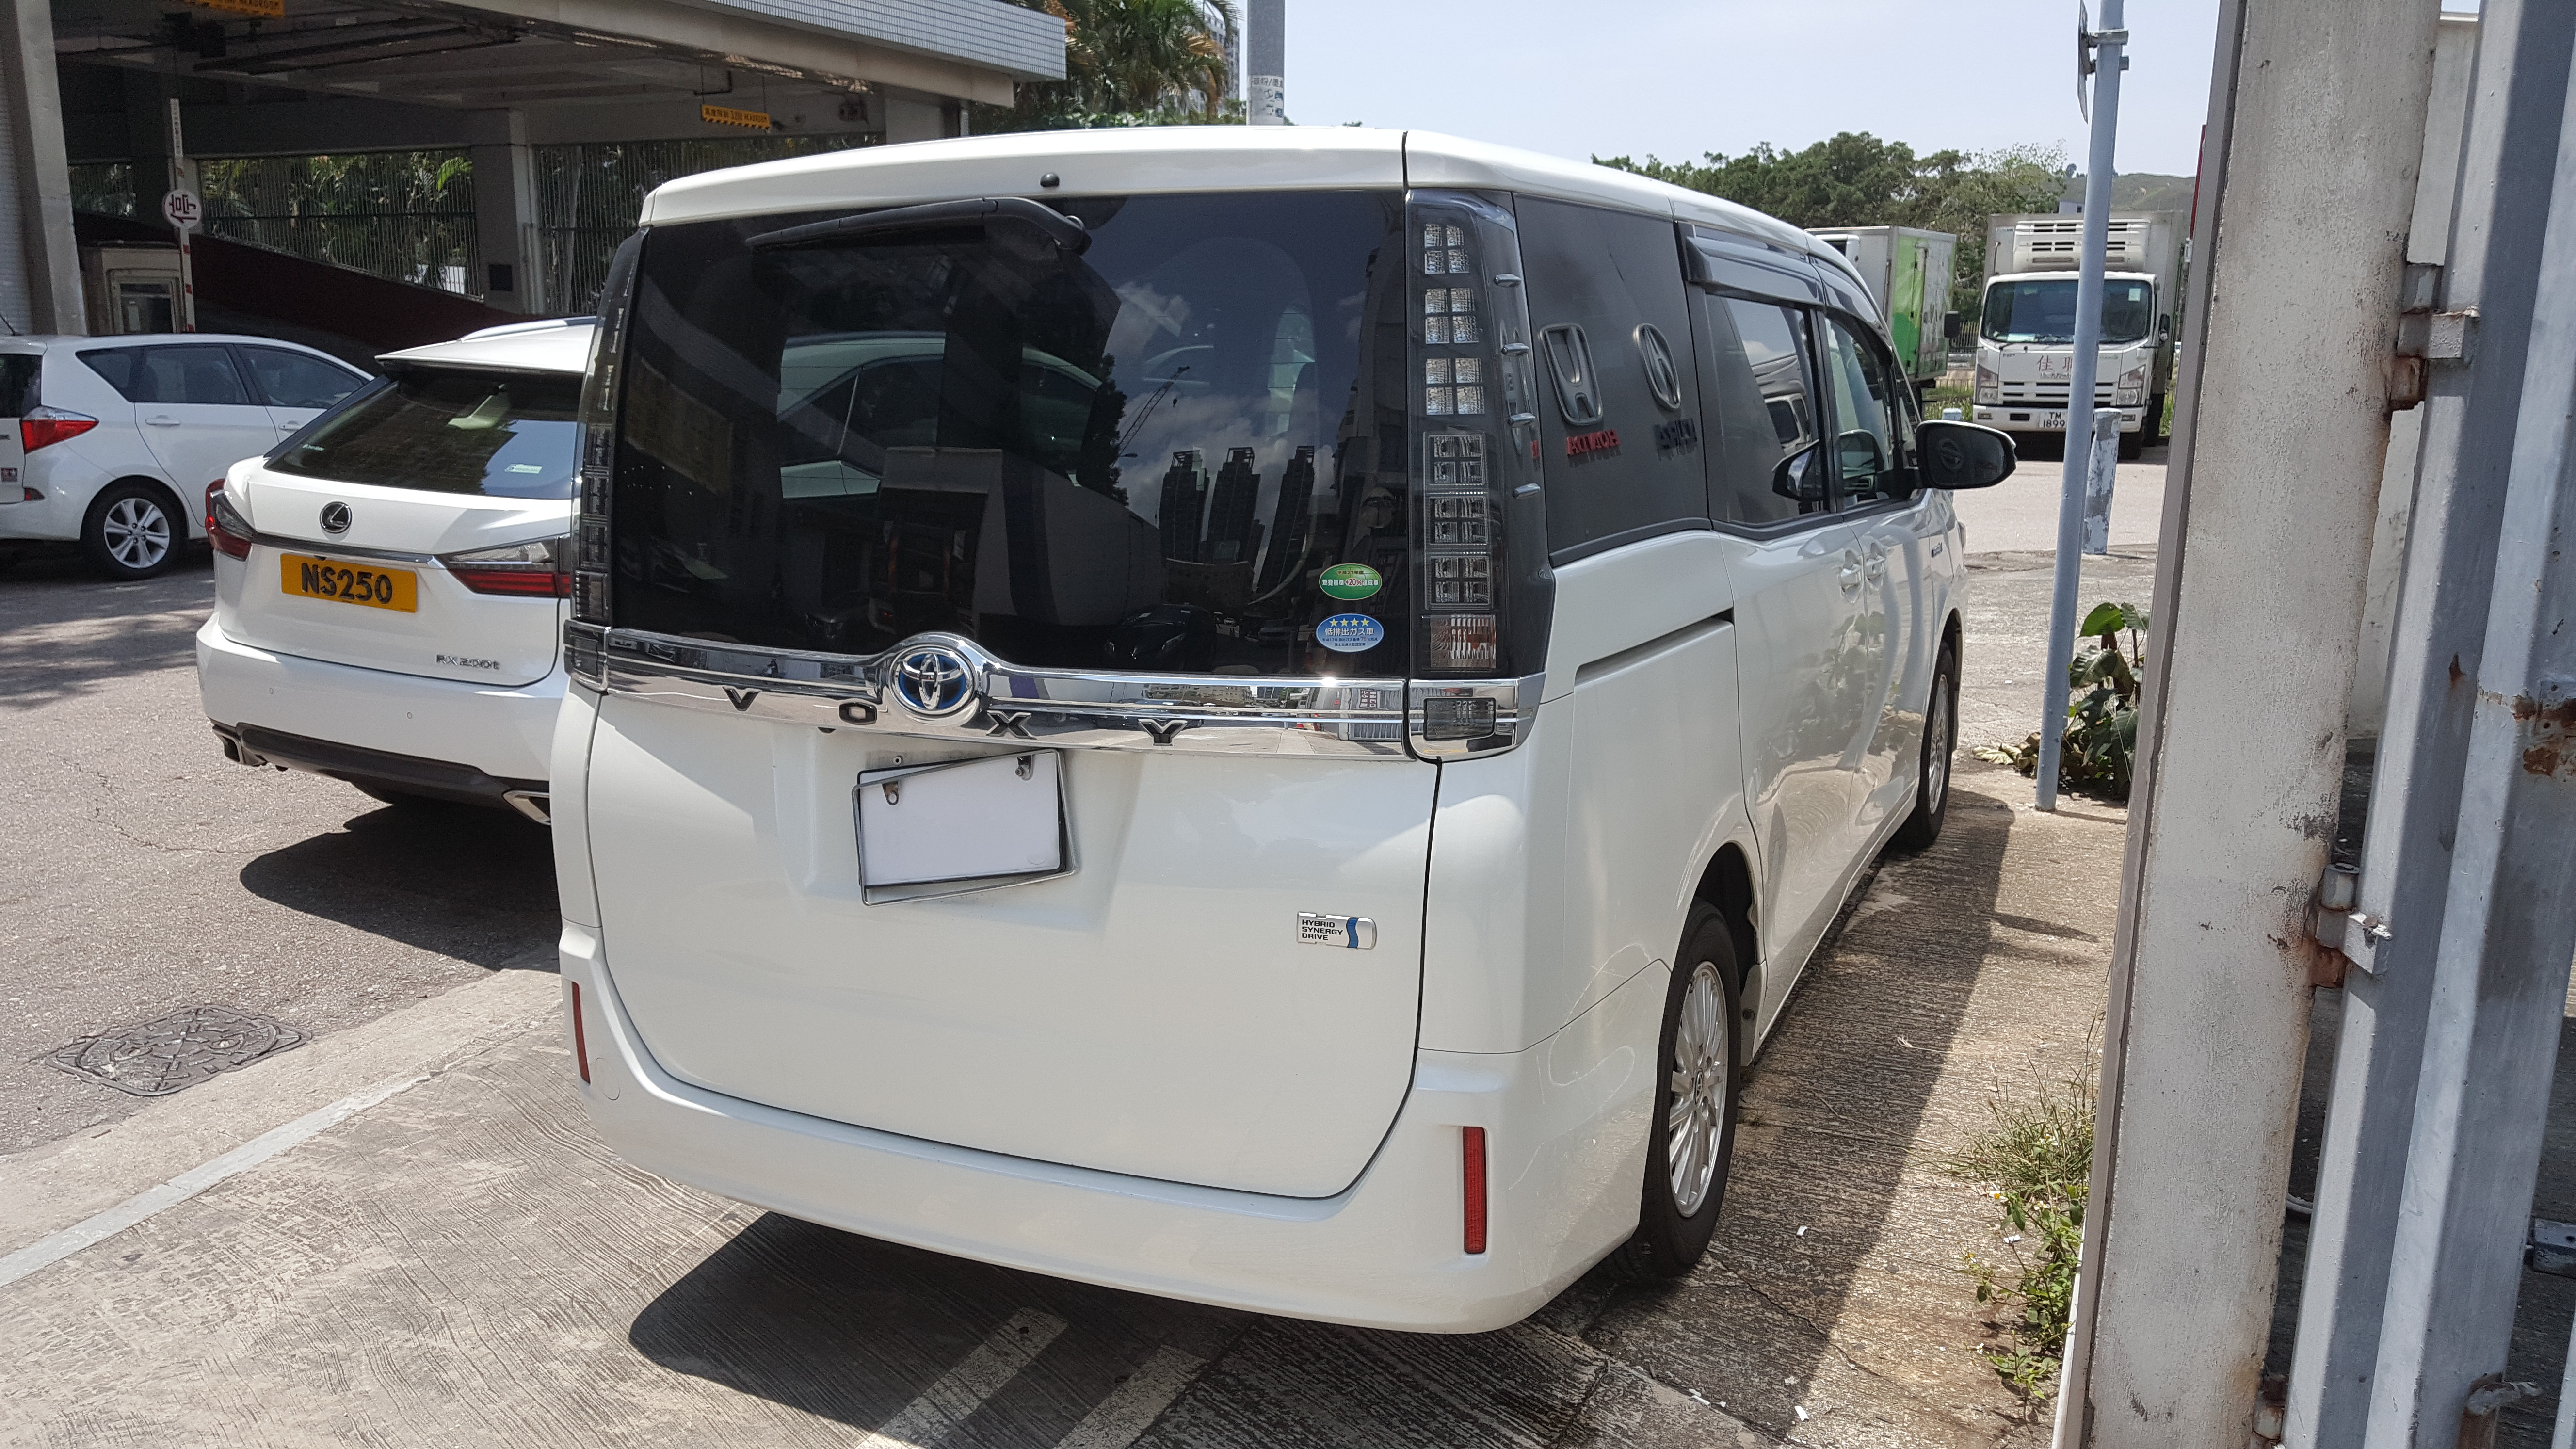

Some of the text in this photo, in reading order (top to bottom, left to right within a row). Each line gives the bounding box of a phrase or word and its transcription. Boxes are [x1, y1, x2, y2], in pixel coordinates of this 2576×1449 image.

[169, 194, 197, 224] 停
[2049, 411, 2061, 419] TM
[301, 563, 393, 605] NS250
[1325, 628, 1374, 636] 低排出ガス車
[436, 654, 458, 666] RX
[722, 686, 1189, 747] VOXY
[1302, 919, 1335, 928] HYBRID
[1302, 927, 1343, 935] SYNERGY
